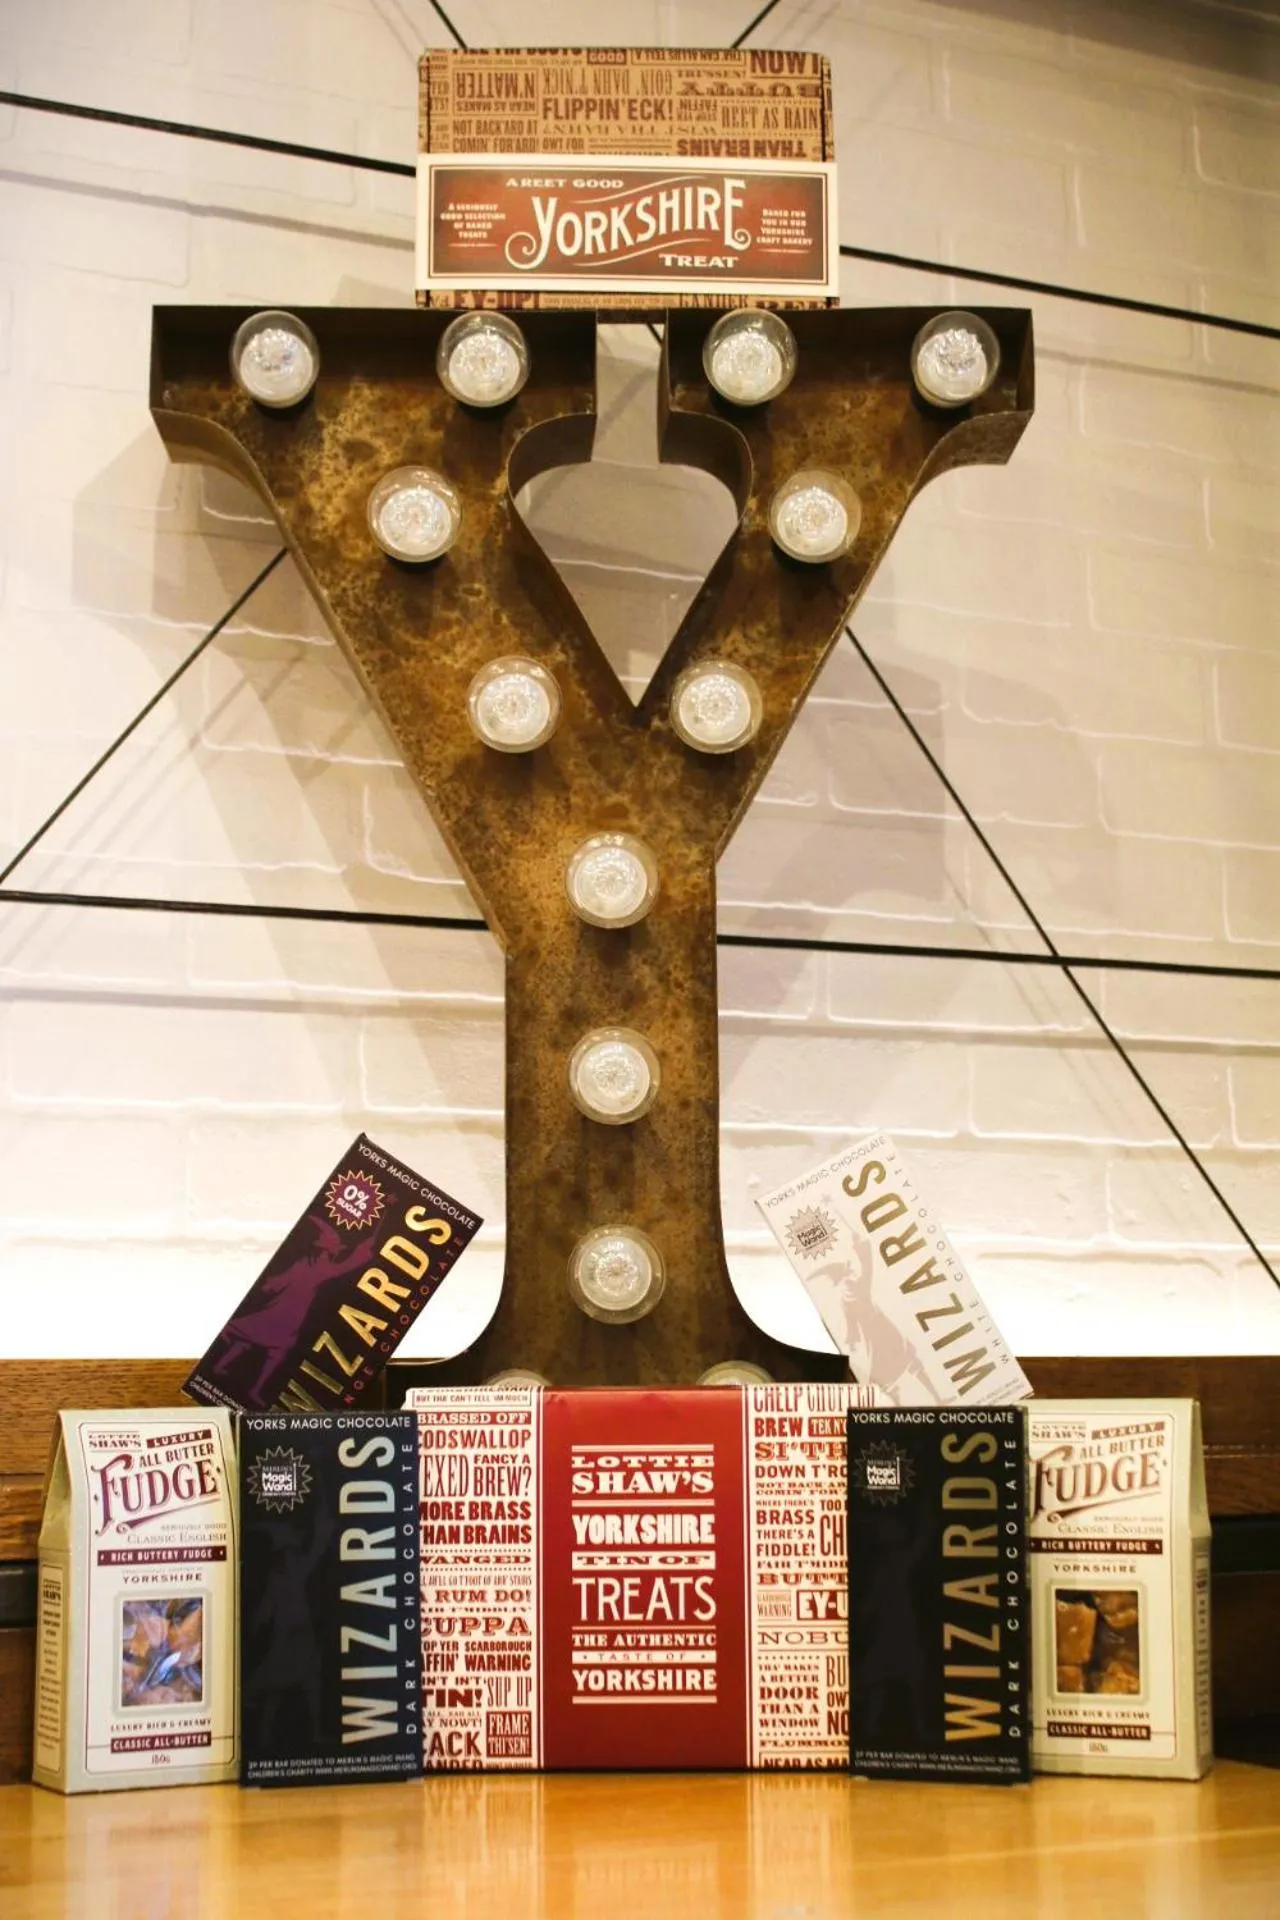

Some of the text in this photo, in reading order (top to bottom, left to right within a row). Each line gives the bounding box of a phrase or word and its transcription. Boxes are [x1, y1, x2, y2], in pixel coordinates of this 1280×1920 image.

[763, 106, 778, 129] AS
[784, 107, 818, 129] RAIN
[453, 120, 471, 135] NOT
[526, 120, 537, 135] AT
[676, 139, 807, 158] THAN BRAINS
[572, 179, 624, 189] GOOD
[504, 177, 752, 270] YORKSHIRE
[761, 218, 778, 226] YOU
[760, 227, 805, 236] YORKSHIRE
[756, 236, 813, 246] CRAFT BAKERY
[658, 253, 739, 269] TREAT
[764, 1136, 888, 1209] YORKS MAGIC CHOCOLATE
[358, 1142, 476, 1230] YORKS MAGIC CHOCOLATE
[343, 1184, 371, 1210] 0%
[886, 1154, 964, 1283] CHOCOLATE
[842, 1160, 997, 1396] WIZARDS
[380, 1236, 464, 1352] CHOCOLATE
[969, 1299, 1010, 1366] WHITE
[754, 1386, 802, 1413] CHELP
[247, 1417, 411, 1430] YORKS MAGIC CHOCOLATE
[418, 1413, 529, 1424] BRASSED OFF
[852, 1412, 1014, 1424] YORKS MAGIC CHOCOLATE
[754, 1417, 803, 1437] BREW
[153, 1431, 204, 1448] LUXURY
[1032, 1431, 1086, 1439] SHAW'S
[89, 1440, 142, 1448] SHAW'S
[1079, 1435, 1165, 1460] ALL BUTTER
[139, 1442, 215, 1468] ALL BUTTER
[474, 1454, 530, 1464] FANCY A
[571, 1455, 714, 1468] LOTTIE
[262, 1472, 292, 1484] Magic
[755, 1465, 805, 1478] DOWN
[866, 1465, 897, 1478] Magic
[263, 1481, 293, 1492] Wand
[473, 1466, 532, 1497] BREW?
[571, 1471, 714, 1494] SHAW'S
[867, 1476, 897, 1486] Wand
[1027, 1445, 1161, 1524] FUDGE
[91, 1453, 218, 1536] FUDGE
[468, 1501, 532, 1521] BRASS
[820, 1499, 842, 1511] TOO
[756, 1510, 815, 1525] BRASS
[418, 1525, 532, 1545] HAN BRAINS
[572, 1513, 715, 1544] YORKSHIRE
[756, 1529, 815, 1539] THERE'S A
[1057, 1523, 1163, 1535] CLASSIC ENGLISH
[127, 1533, 227, 1545] CLASSIC ENGLISH
[1041, 1540, 1148, 1551] RICH BUTTERY FUDGE
[111, 1549, 212, 1562] RICH BUTTERY FUDGE
[756, 1543, 815, 1557] FIDDLE!
[576, 1555, 711, 1566] TIN OF
[1053, 1564, 1137, 1573] YORKSHIRE
[122, 1573, 202, 1584] YORKSHIRE
[338, 1436, 398, 1745] WIZARDS
[402, 1444, 417, 1734] DARK CHOCOLATE
[940, 1432, 1002, 1741] WIZARDS
[1004, 1440, 1021, 1738] DARK CHOCOLATE
[435, 1589, 531, 1603] RUM DO!
[572, 1576, 717, 1622] TREATS
[757, 1603, 792, 1616] WARNING
[572, 1633, 717, 1648] THE AUTHENTIC
[757, 1631, 848, 1645] NOBU
[440, 1641, 459, 1652] YER
[464, 1641, 532, 1651] SCARBOROUGH
[464, 1654, 532, 1672] WARNING
[598, 1652, 687, 1660] TASTE OF
[572, 1669, 717, 1691] YORKSHIRE
[770, 1674, 819, 1682] BETTER
[516, 1676, 532, 1707] UP
[759, 1686, 819, 1700] DOOR
[759, 1704, 819, 1714] THAN A
[1082, 1709, 1103, 1718] RICH
[110, 1718, 212, 1732] LUXURY RICH CREAMY
[440, 1718, 482, 1728] NOWT!
[489, 1714, 530, 1735] FRAME
[759, 1718, 820, 1728] WINDOW
[1049, 1722, 1148, 1738] CLASSIC ALL-BUTTER
[113, 1735, 209, 1750] CLASSIC ALL-BUTTER
[259, 1760, 273, 1769] PER
[275, 1760, 289, 1768] BAR
[290, 1758, 324, 1768] DONATED
[370, 1754, 392, 1763] MAGIC
[895, 1752, 927, 1761] DONATED
[286, 1767, 315, 1777] CHARITY
